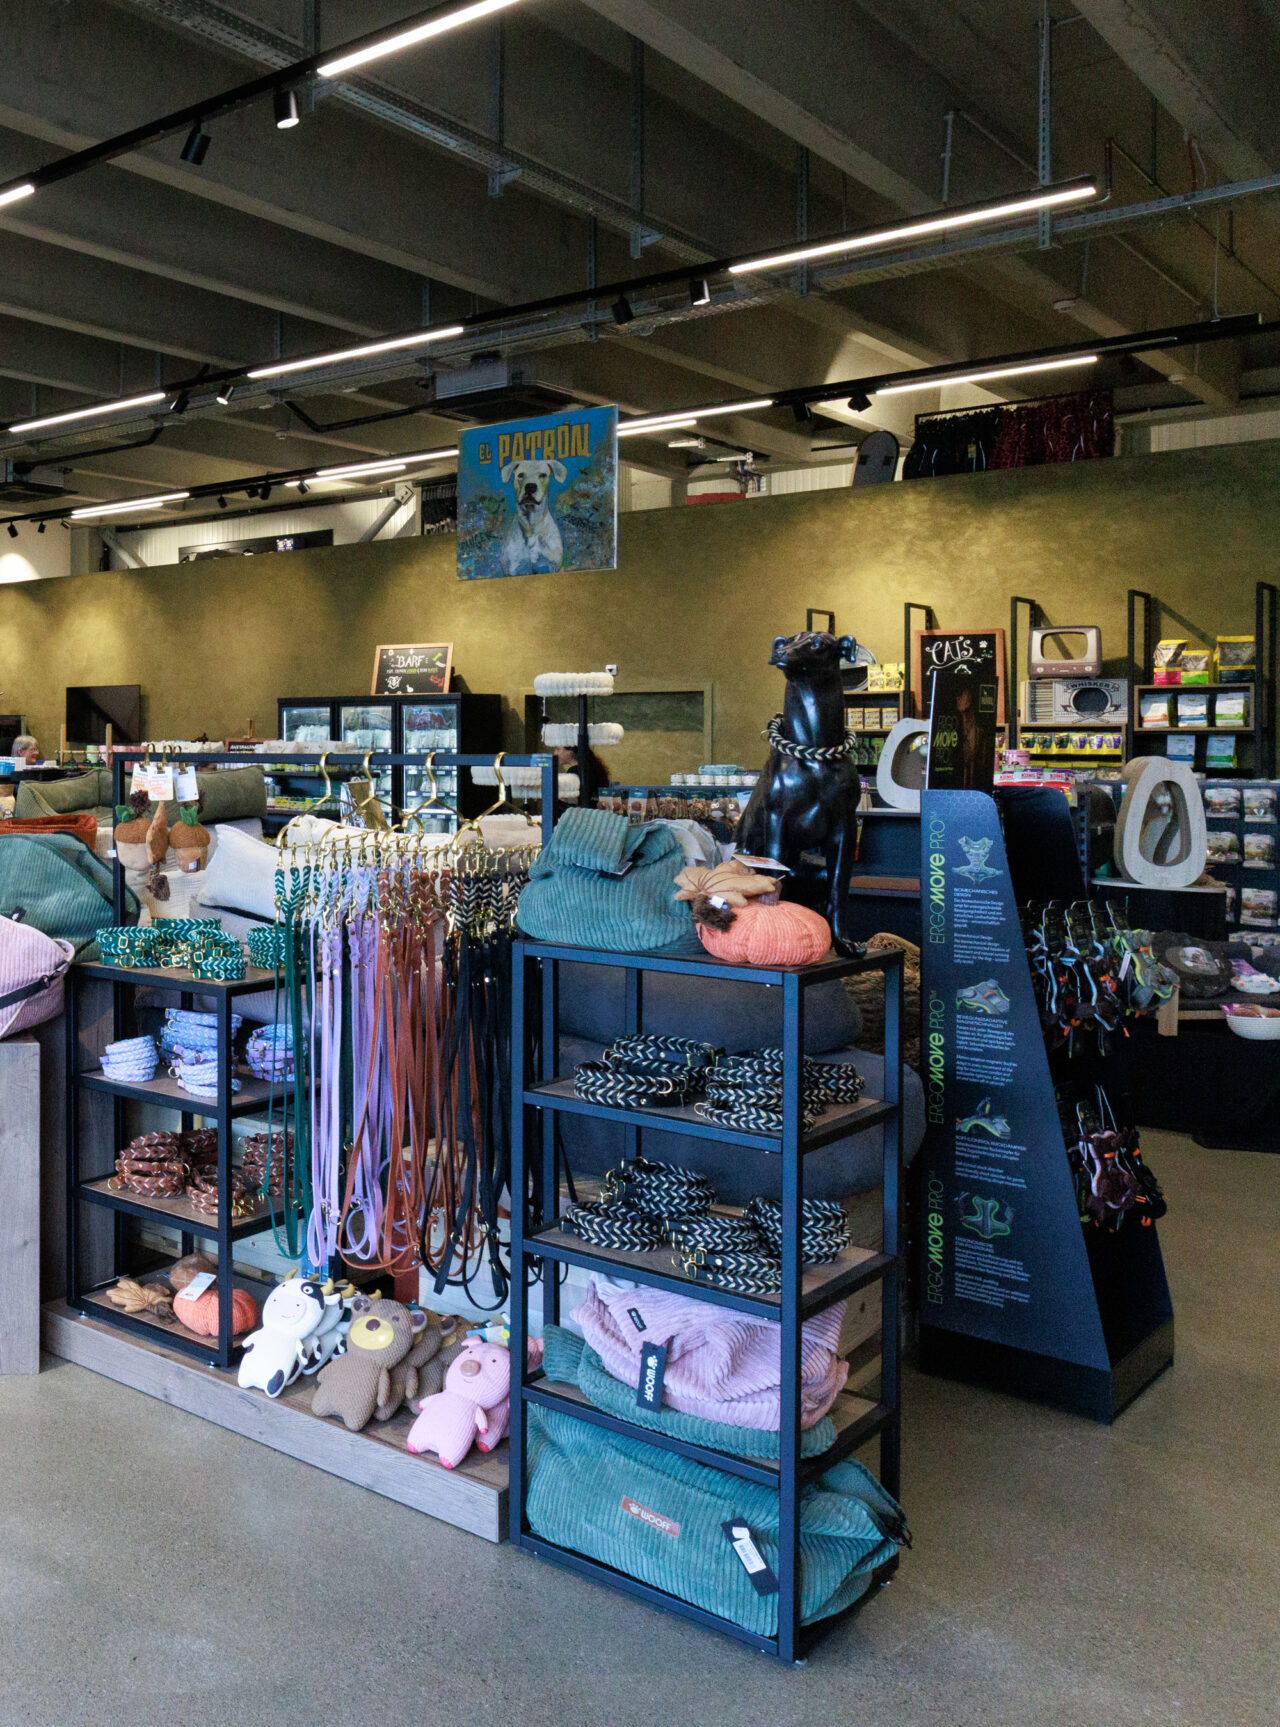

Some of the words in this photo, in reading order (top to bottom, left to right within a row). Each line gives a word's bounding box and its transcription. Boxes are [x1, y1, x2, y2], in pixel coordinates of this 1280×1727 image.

[393, 655, 425, 668] BARF
[925, 636, 974, 665] CATS
[644, 1368, 656, 1402] WOOFF
[640, 1510, 671, 1530] WOOFF
